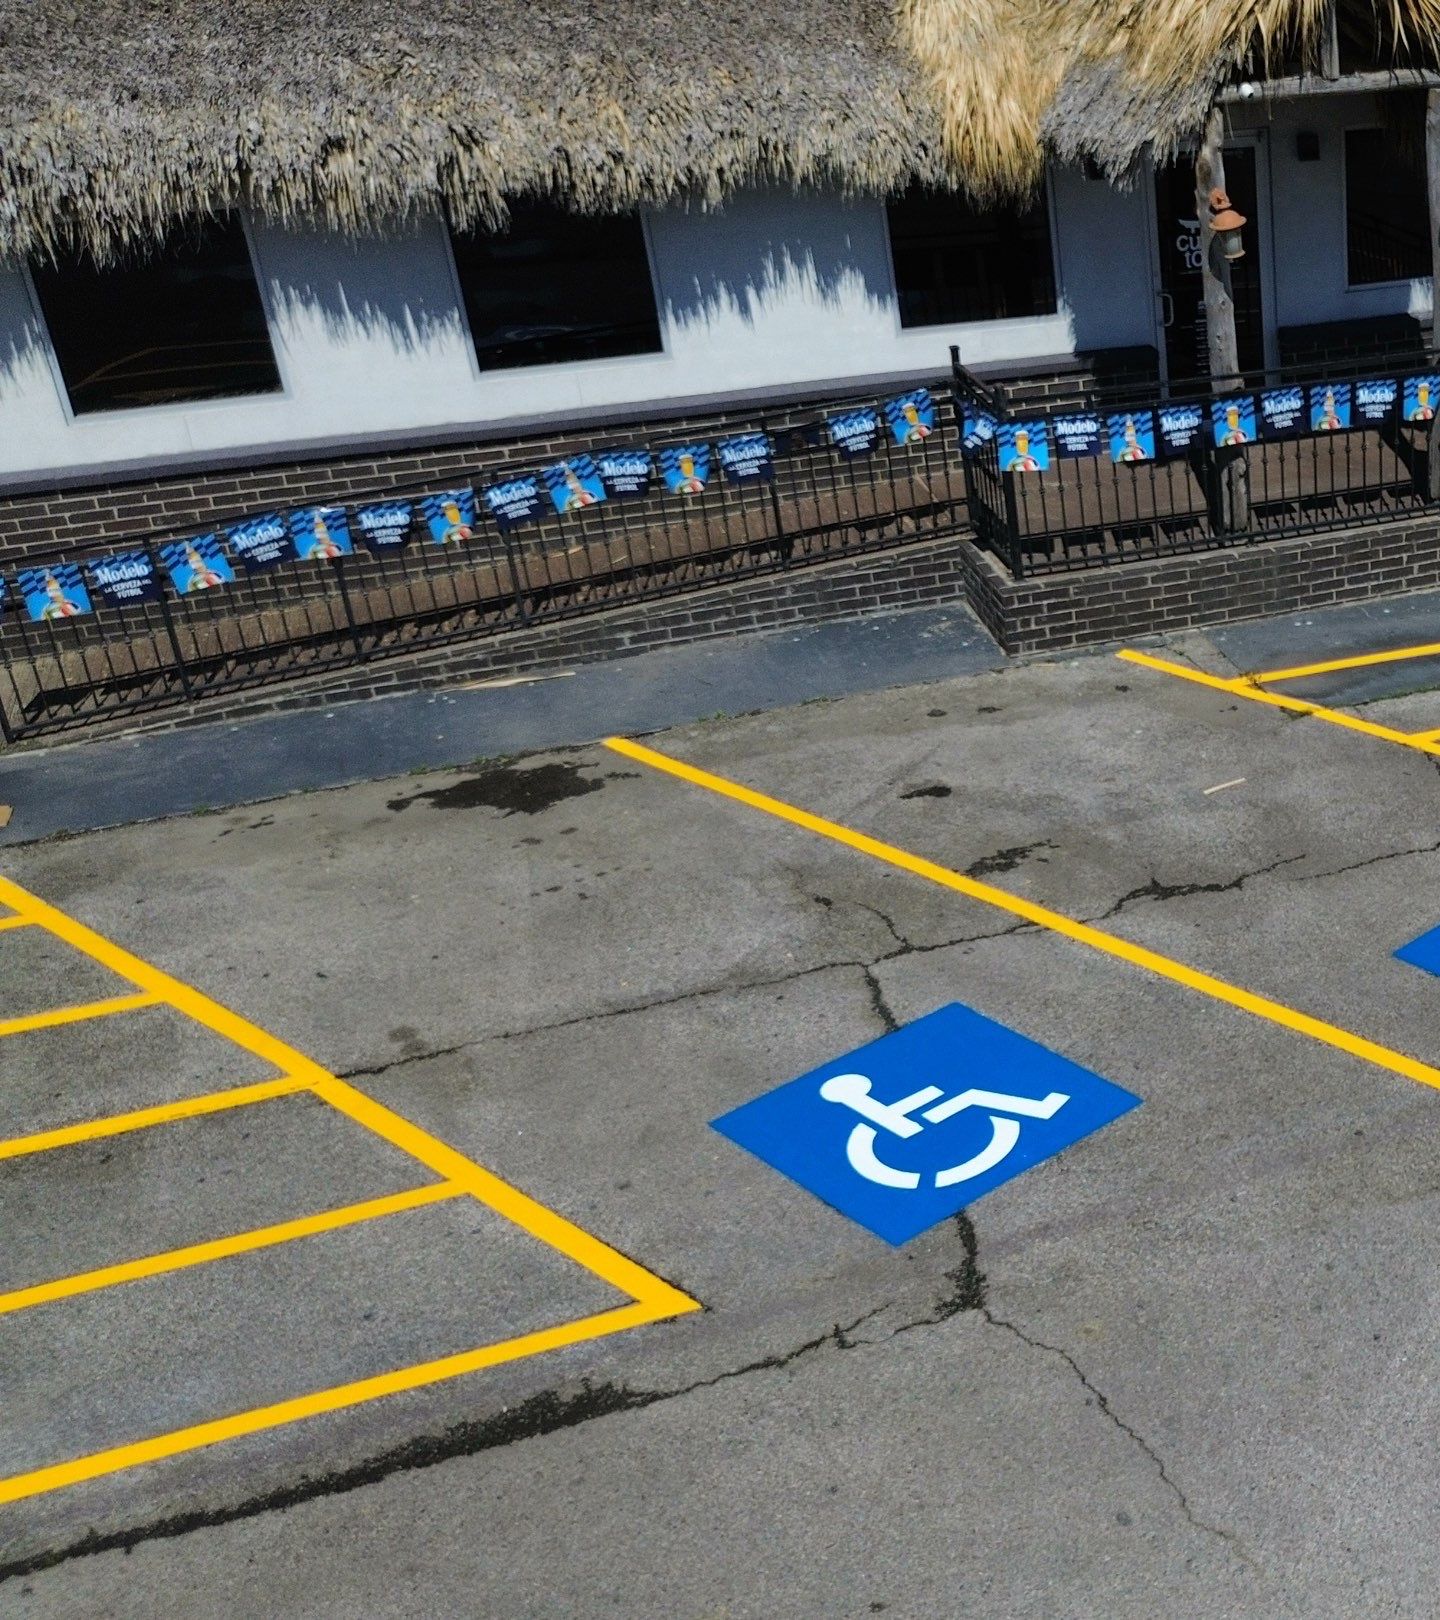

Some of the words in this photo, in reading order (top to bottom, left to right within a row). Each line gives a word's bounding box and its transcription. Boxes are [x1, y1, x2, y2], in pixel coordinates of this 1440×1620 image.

[1263, 397, 1301, 416] Modelo
[833, 418, 875, 440] Modelo
[1056, 419, 1097, 434] Modelo
[1161, 414, 1199, 432] Modelo
[724, 444, 767, 463] Modelo
[603, 460, 648, 477] Modelo
[489, 484, 536, 506] Modelo
[361, 511, 410, 529] Modelo
[234, 526, 284, 550] Modelo
[97, 563, 148, 584] Modelo
